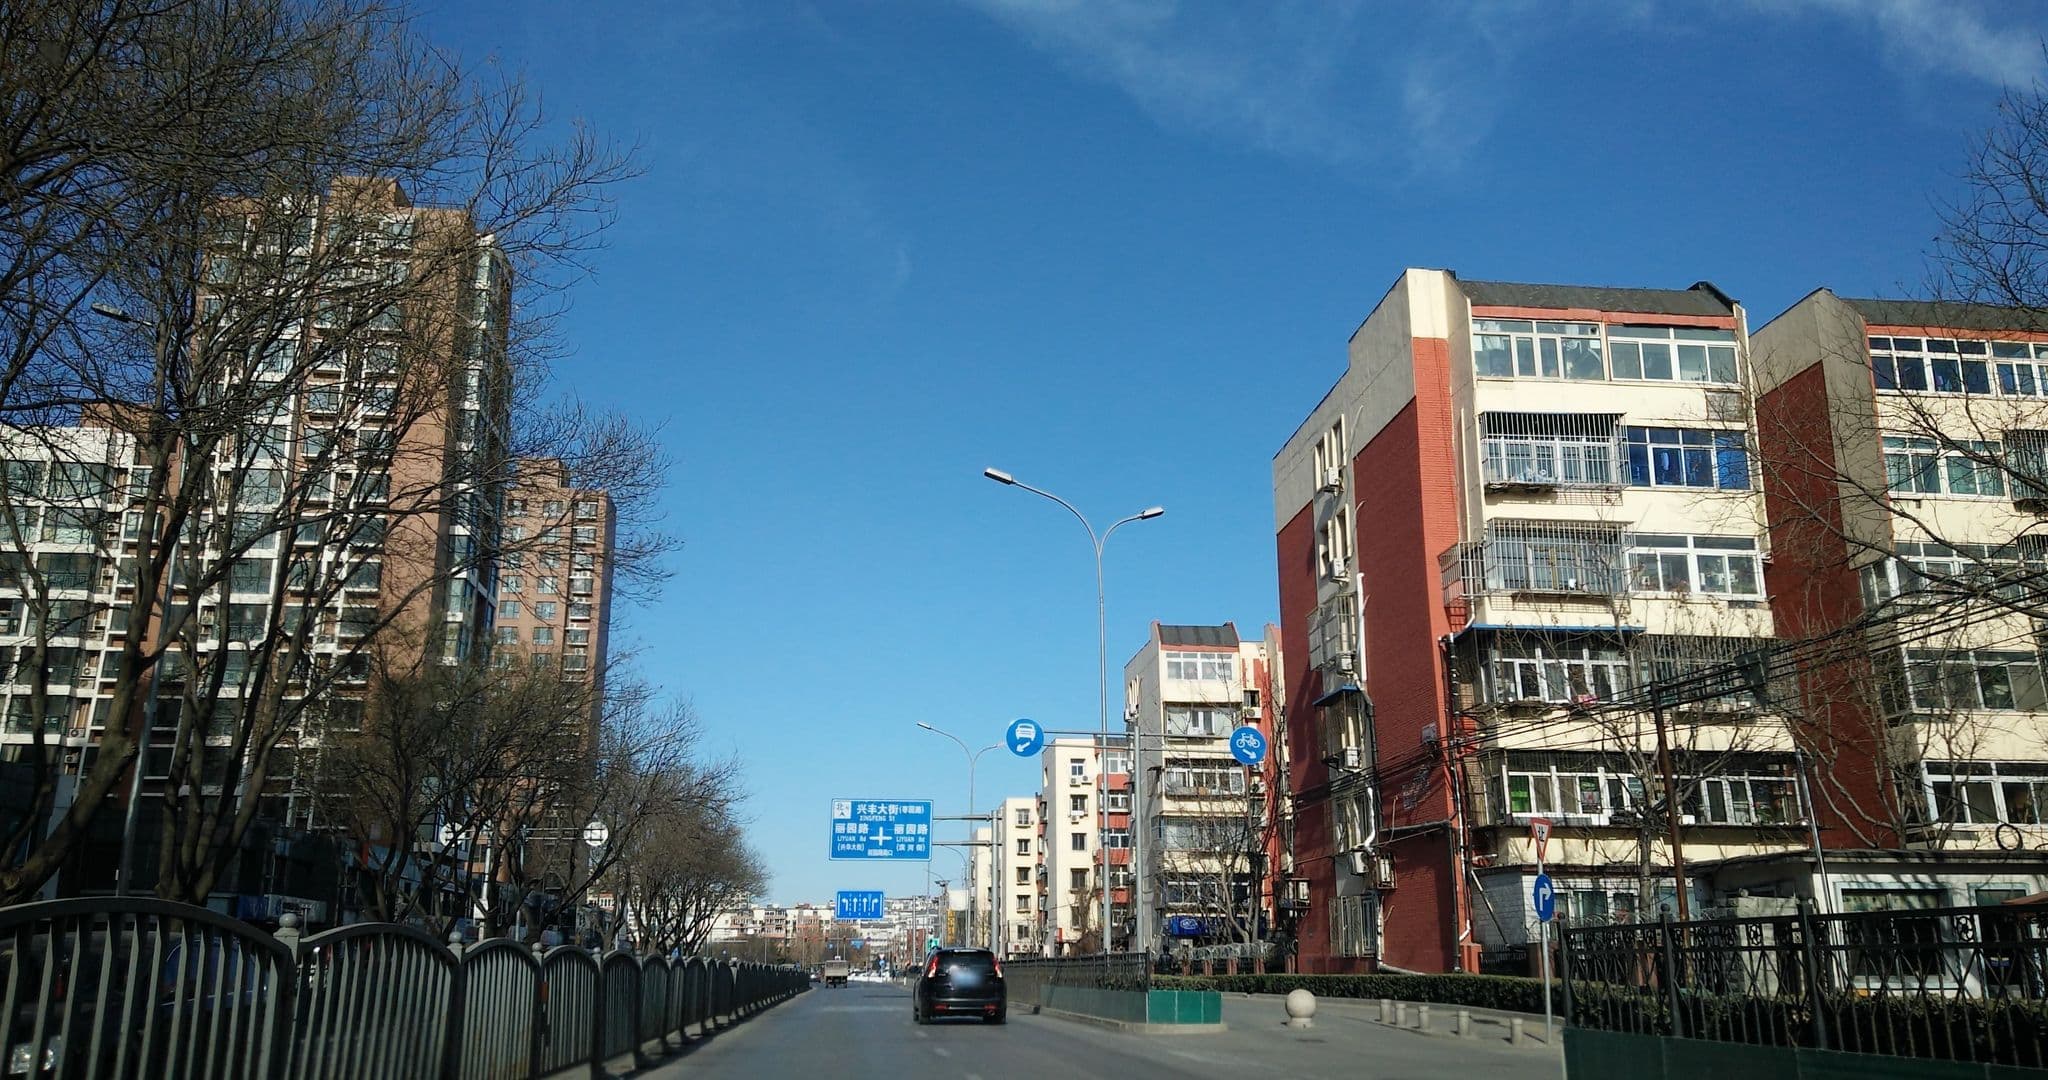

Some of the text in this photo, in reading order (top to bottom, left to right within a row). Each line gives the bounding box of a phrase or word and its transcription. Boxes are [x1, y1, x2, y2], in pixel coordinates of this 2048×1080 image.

[857, 804, 898, 815] 兴丰大街
[835, 823, 868, 834] 丽园路
[894, 823, 928, 835] 丽园路
